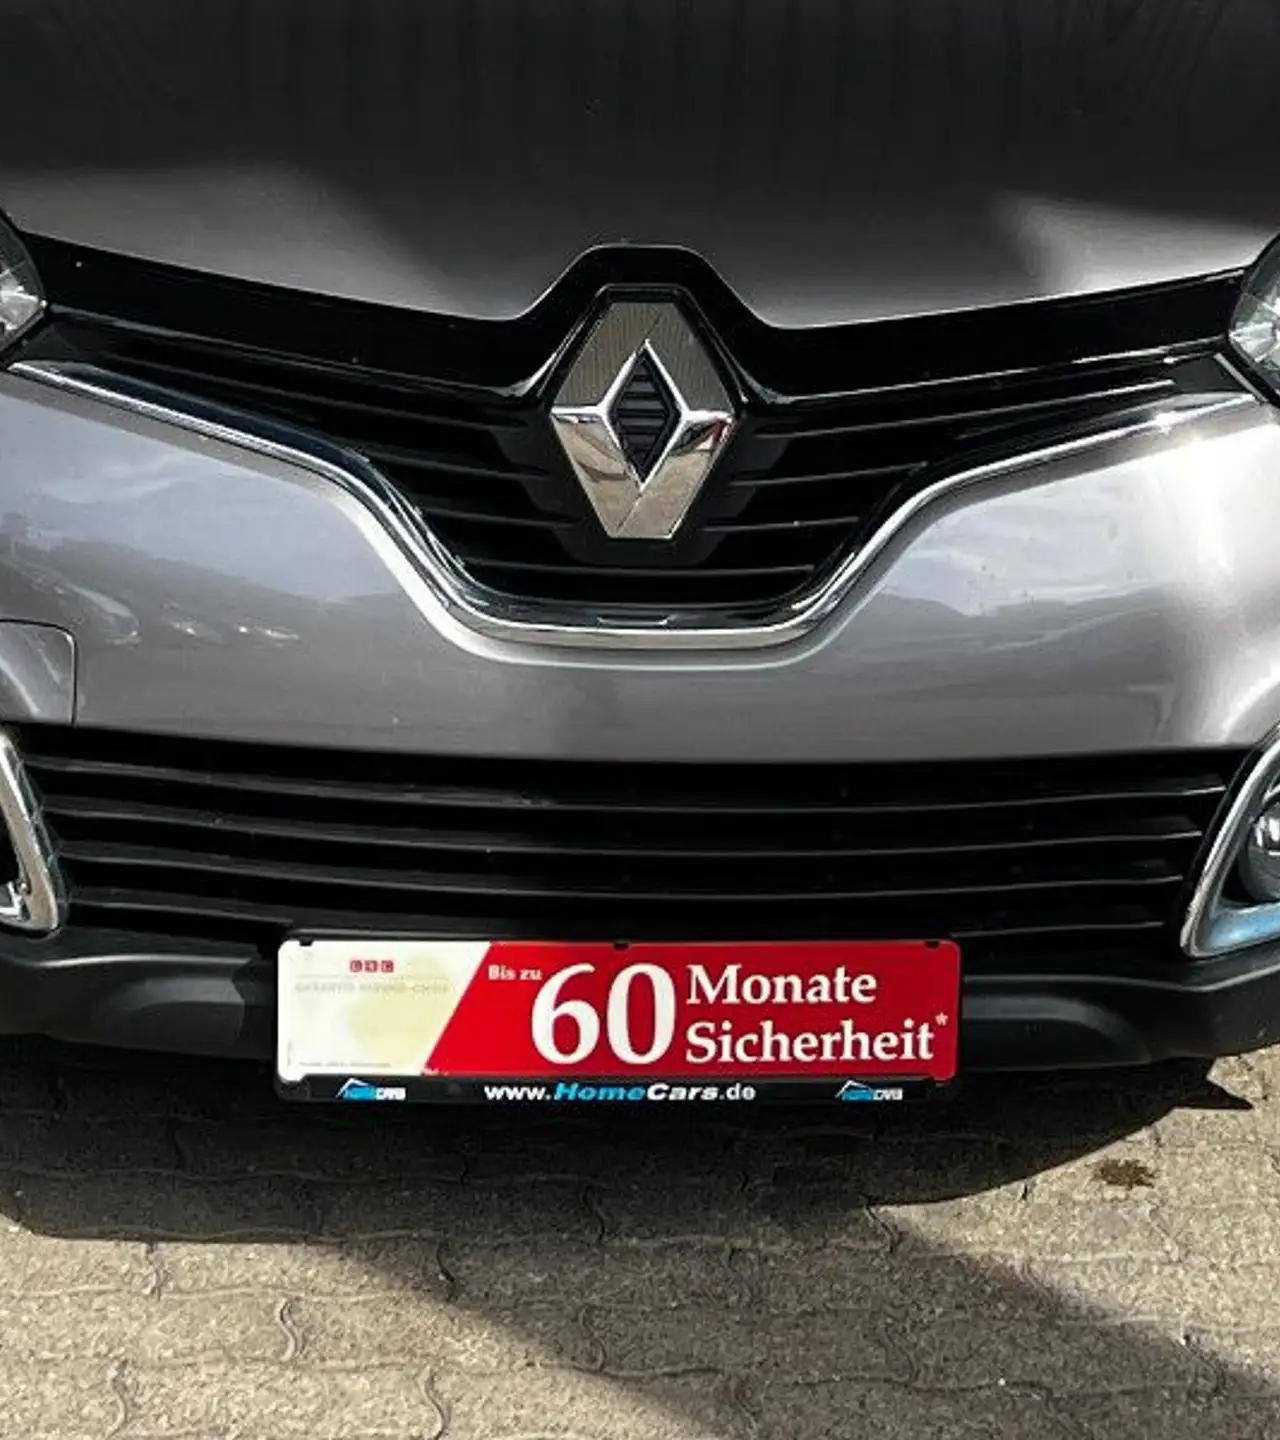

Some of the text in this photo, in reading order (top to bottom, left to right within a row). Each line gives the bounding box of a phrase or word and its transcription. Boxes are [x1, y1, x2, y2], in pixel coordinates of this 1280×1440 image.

[488, 964, 542, 981] Bis zu
[686, 964, 877, 1004] Monate
[531, 963, 676, 1065] 60
[484, 1082, 756, 1101] www.HomeCars.de
